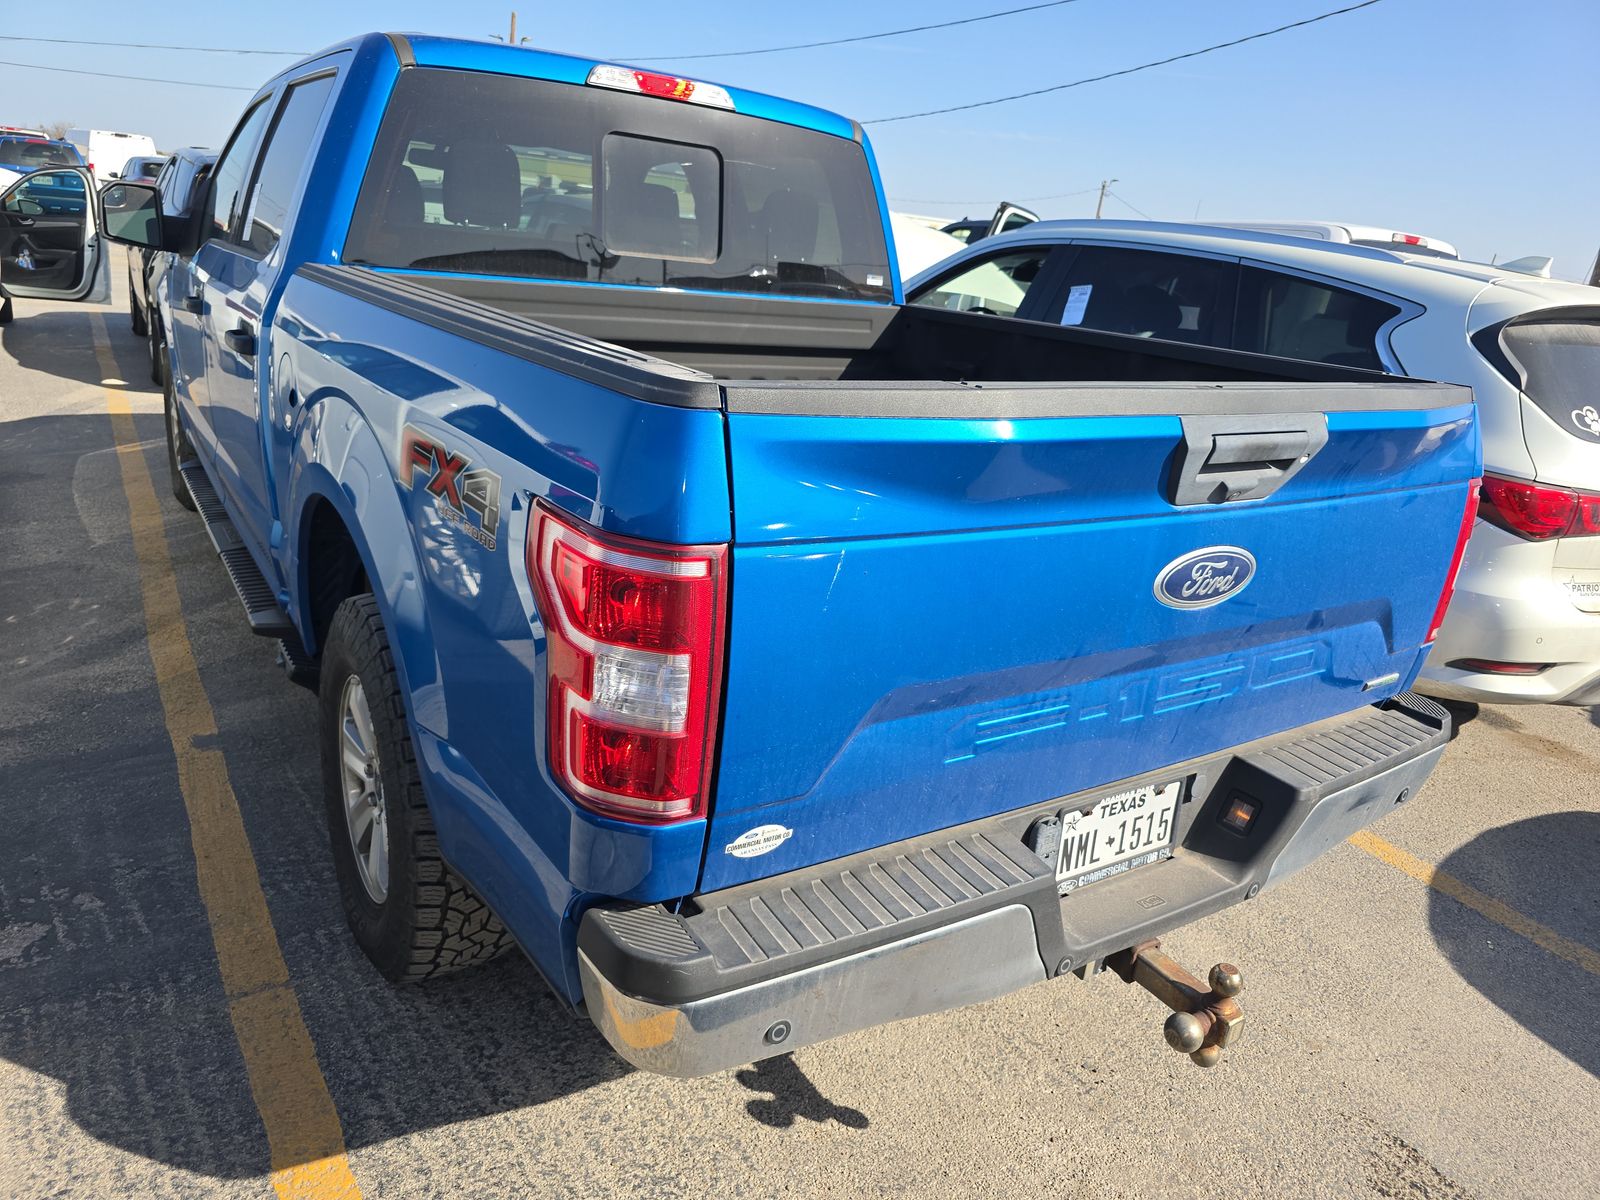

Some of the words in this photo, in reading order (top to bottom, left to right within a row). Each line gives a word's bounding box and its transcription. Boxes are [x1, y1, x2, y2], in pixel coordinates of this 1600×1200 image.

[399, 422, 502, 538] FX4
[463, 519, 497, 552] ROAD
[1181, 560, 1239, 598] Ford
[944, 640, 1330, 764] F-150
[1100, 793, 1147, 819] TEXAS
[727, 839, 762, 852] COMMERCIAL
[763, 834, 782, 843] MOTOR
[1060, 829, 1100, 874] NML
[1115, 806, 1171, 856] 1515
[1078, 860, 1130, 887] COMMERCIAL
[1131, 851, 1159, 869] MOTOR
